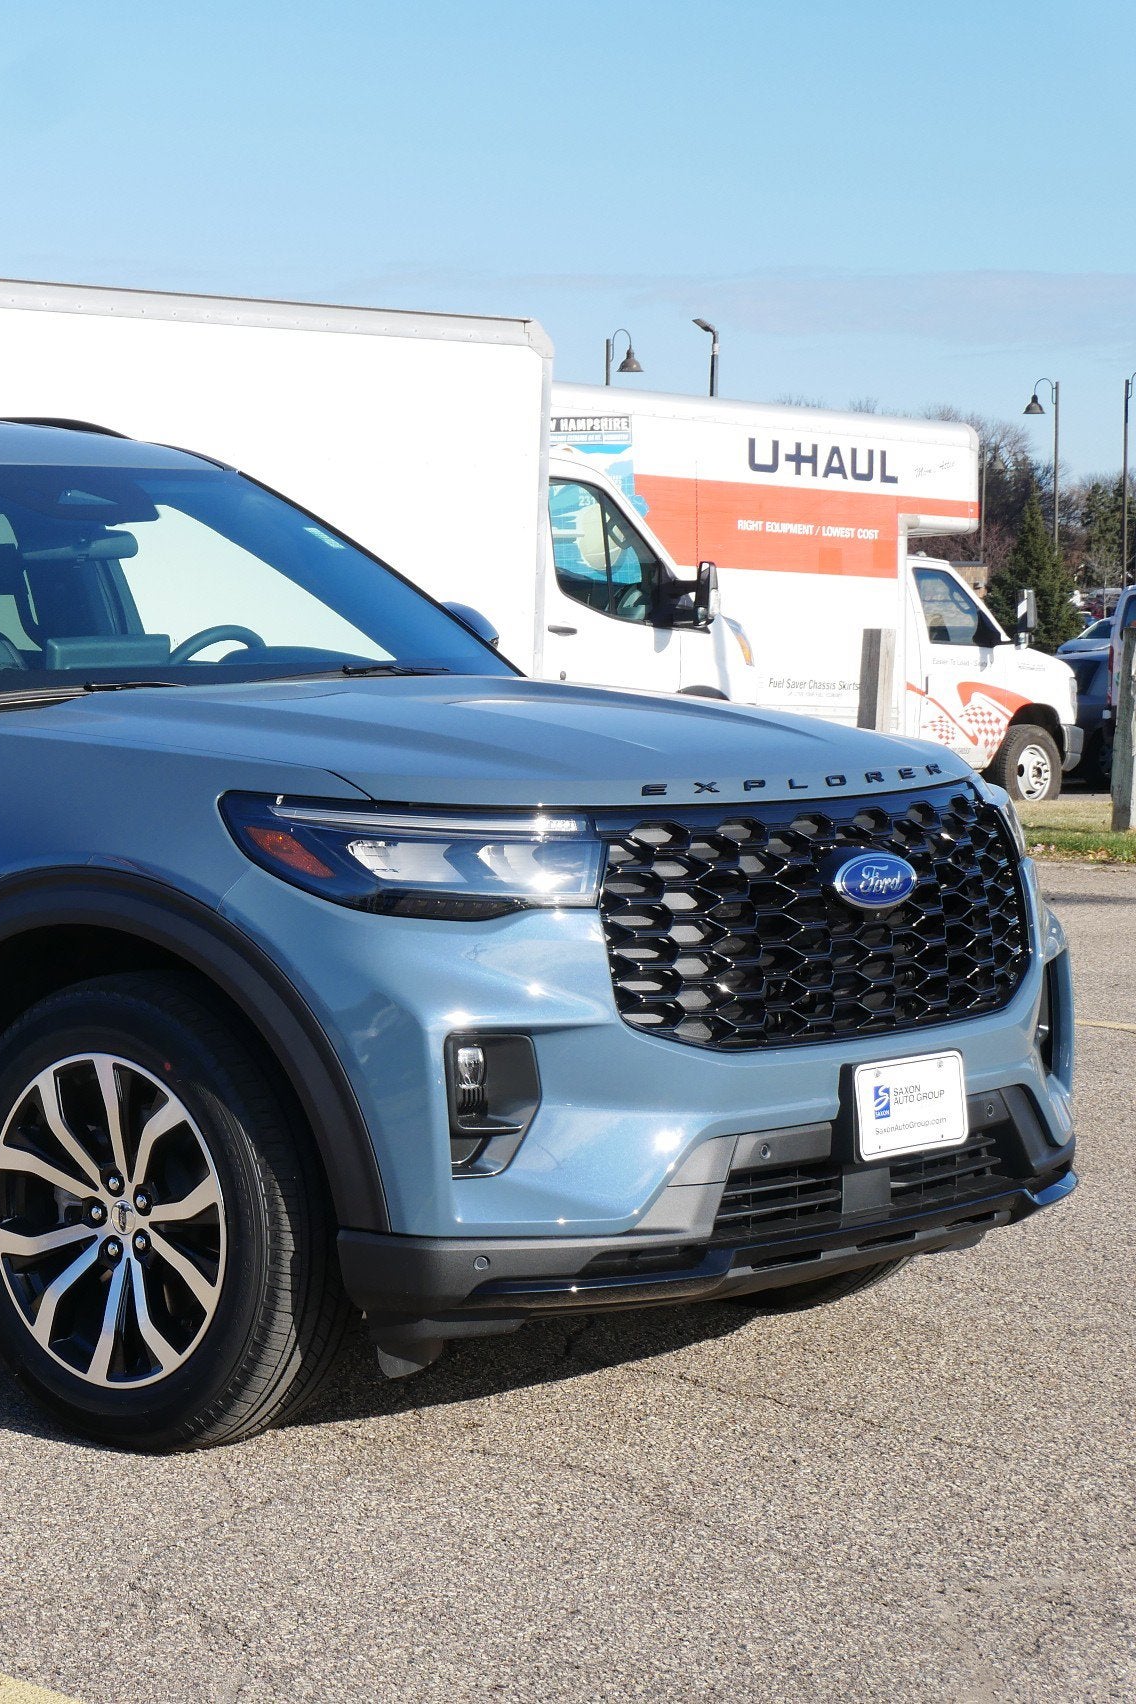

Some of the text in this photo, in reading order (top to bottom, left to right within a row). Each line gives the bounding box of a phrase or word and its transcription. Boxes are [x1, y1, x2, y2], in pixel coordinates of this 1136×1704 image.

[559, 417, 630, 431] HAMPSHIRE
[748, 437, 899, 484] U-HAUL
[737, 519, 764, 531] RIGHT
[765, 521, 815, 536] EQUIPMENT
[822, 525, 855, 538] LOWEST
[857, 528, 880, 540] COST
[768, 677, 860, 691] Fuel Saver Chassis Skirts
[641, 763, 942, 796] EXPLORER
[860, 865, 903, 894] Ford
[894, 1085, 921, 1097] SAXON
[894, 1090, 945, 1105] AUTO GROUP
